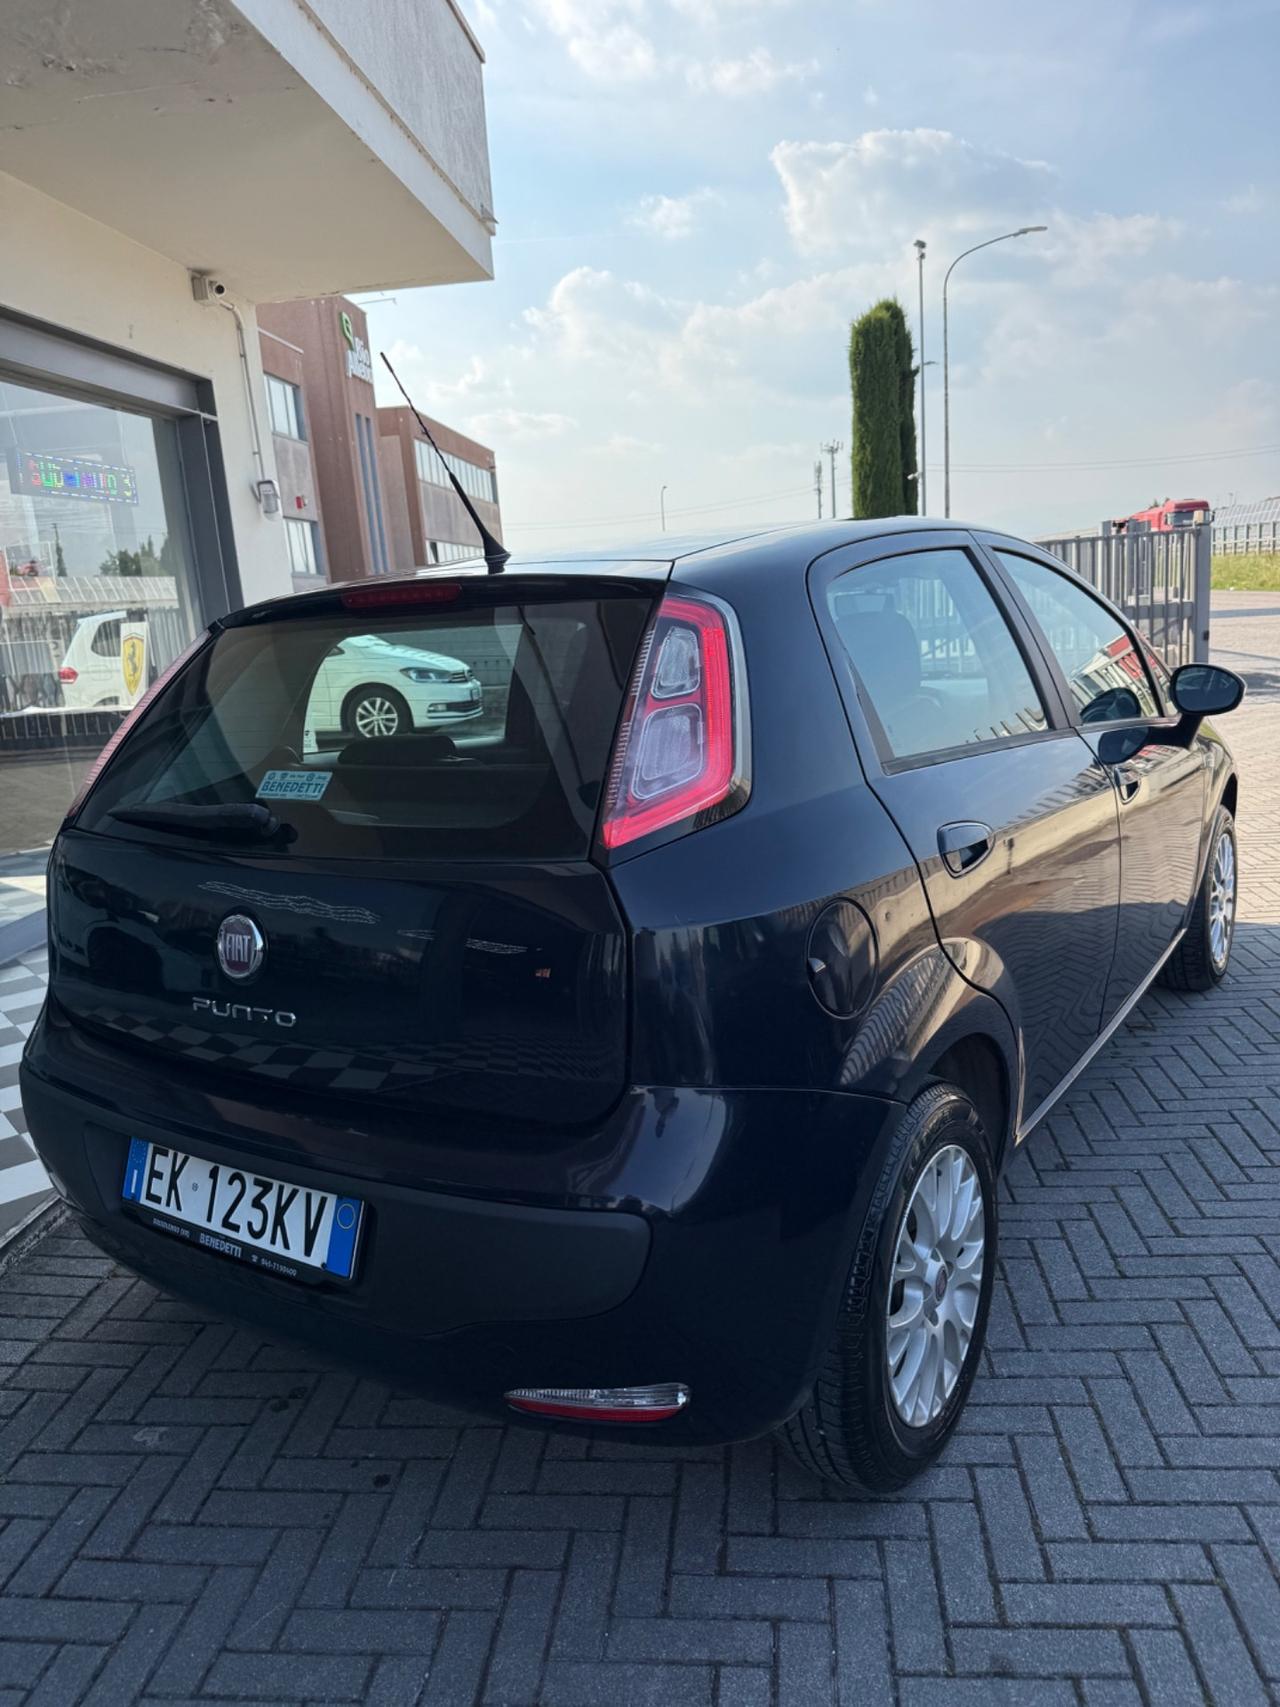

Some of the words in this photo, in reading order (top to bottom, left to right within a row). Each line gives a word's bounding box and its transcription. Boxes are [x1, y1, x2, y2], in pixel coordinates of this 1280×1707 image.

[261, 781, 324, 794] BENEDETTI
[226, 933, 251, 963] FIAT
[192, 996, 296, 1027] PUNTO
[145, 1146, 190, 1212] EK
[206, 1165, 328, 1258] 123KV
[199, 1232, 242, 1258] BENEDETTI
